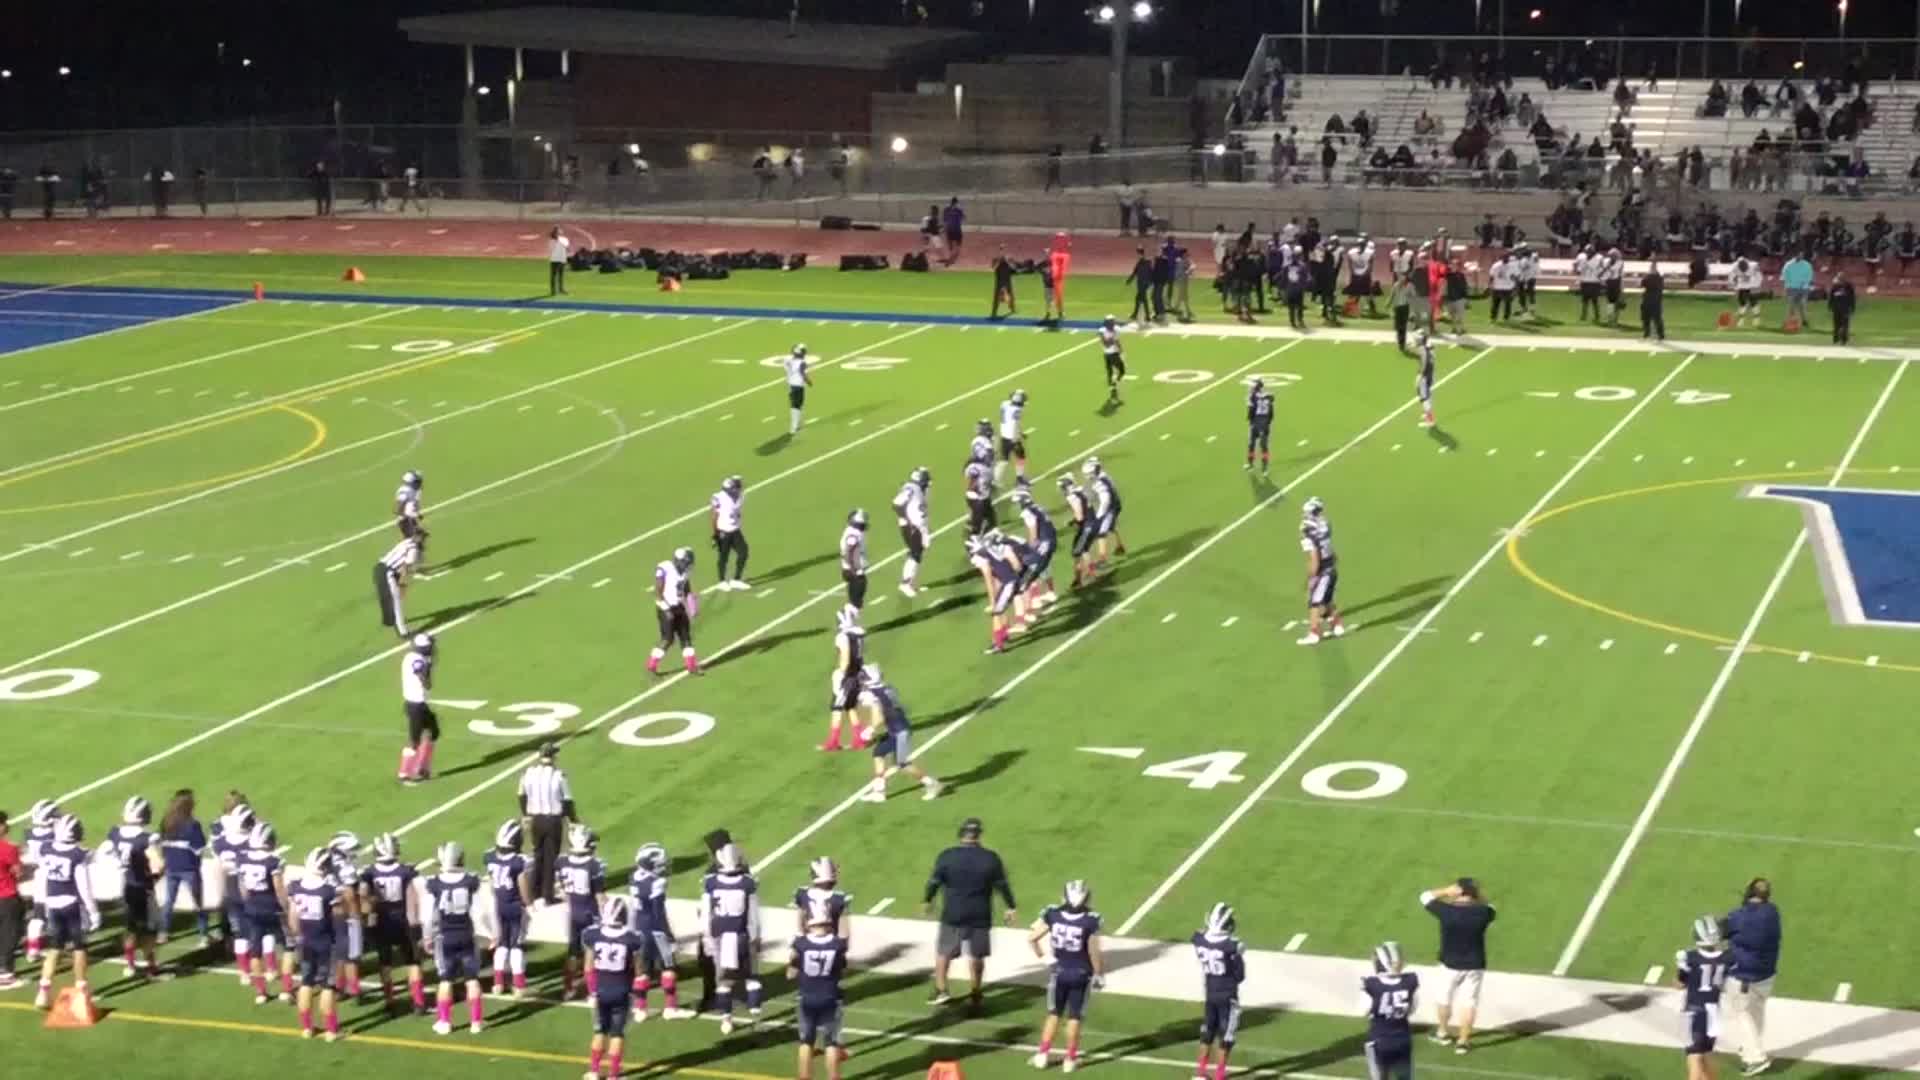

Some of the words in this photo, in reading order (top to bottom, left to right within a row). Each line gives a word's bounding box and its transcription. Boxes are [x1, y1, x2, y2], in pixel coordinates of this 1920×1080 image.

[1574, 385, 1731, 404] 40
[468, 701, 715, 746] 30
[1141, 751, 1408, 799] 40
[803, 949, 837, 978] 67
